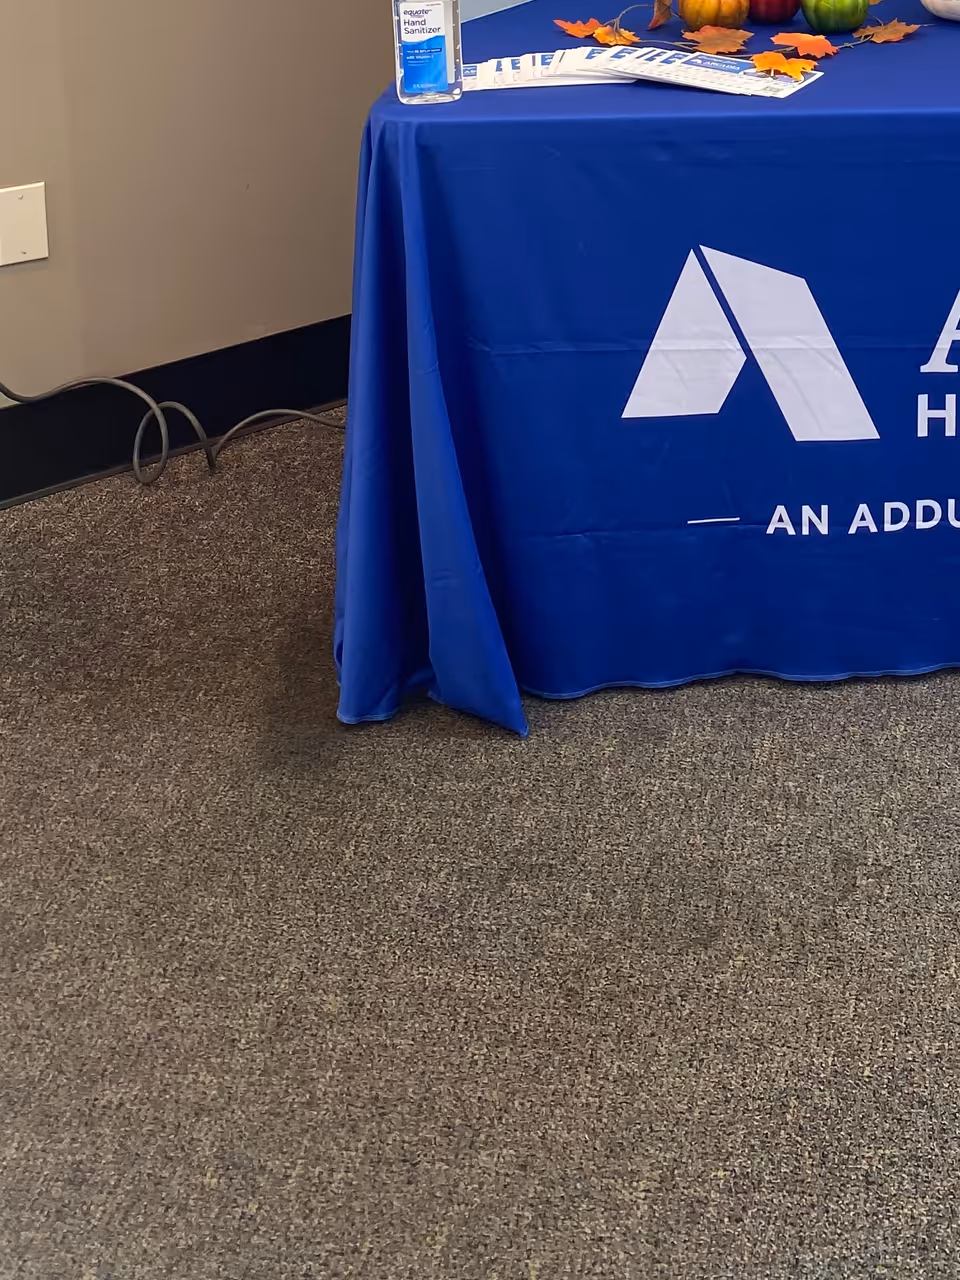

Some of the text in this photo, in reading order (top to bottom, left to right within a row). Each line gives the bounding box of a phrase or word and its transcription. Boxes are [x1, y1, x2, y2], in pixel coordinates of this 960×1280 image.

[403, 8, 430, 16] equate
[403, 18, 427, 27] Hand
[403, 27, 441, 35] Sanitizer
[766, 504, 829, 535] AN
